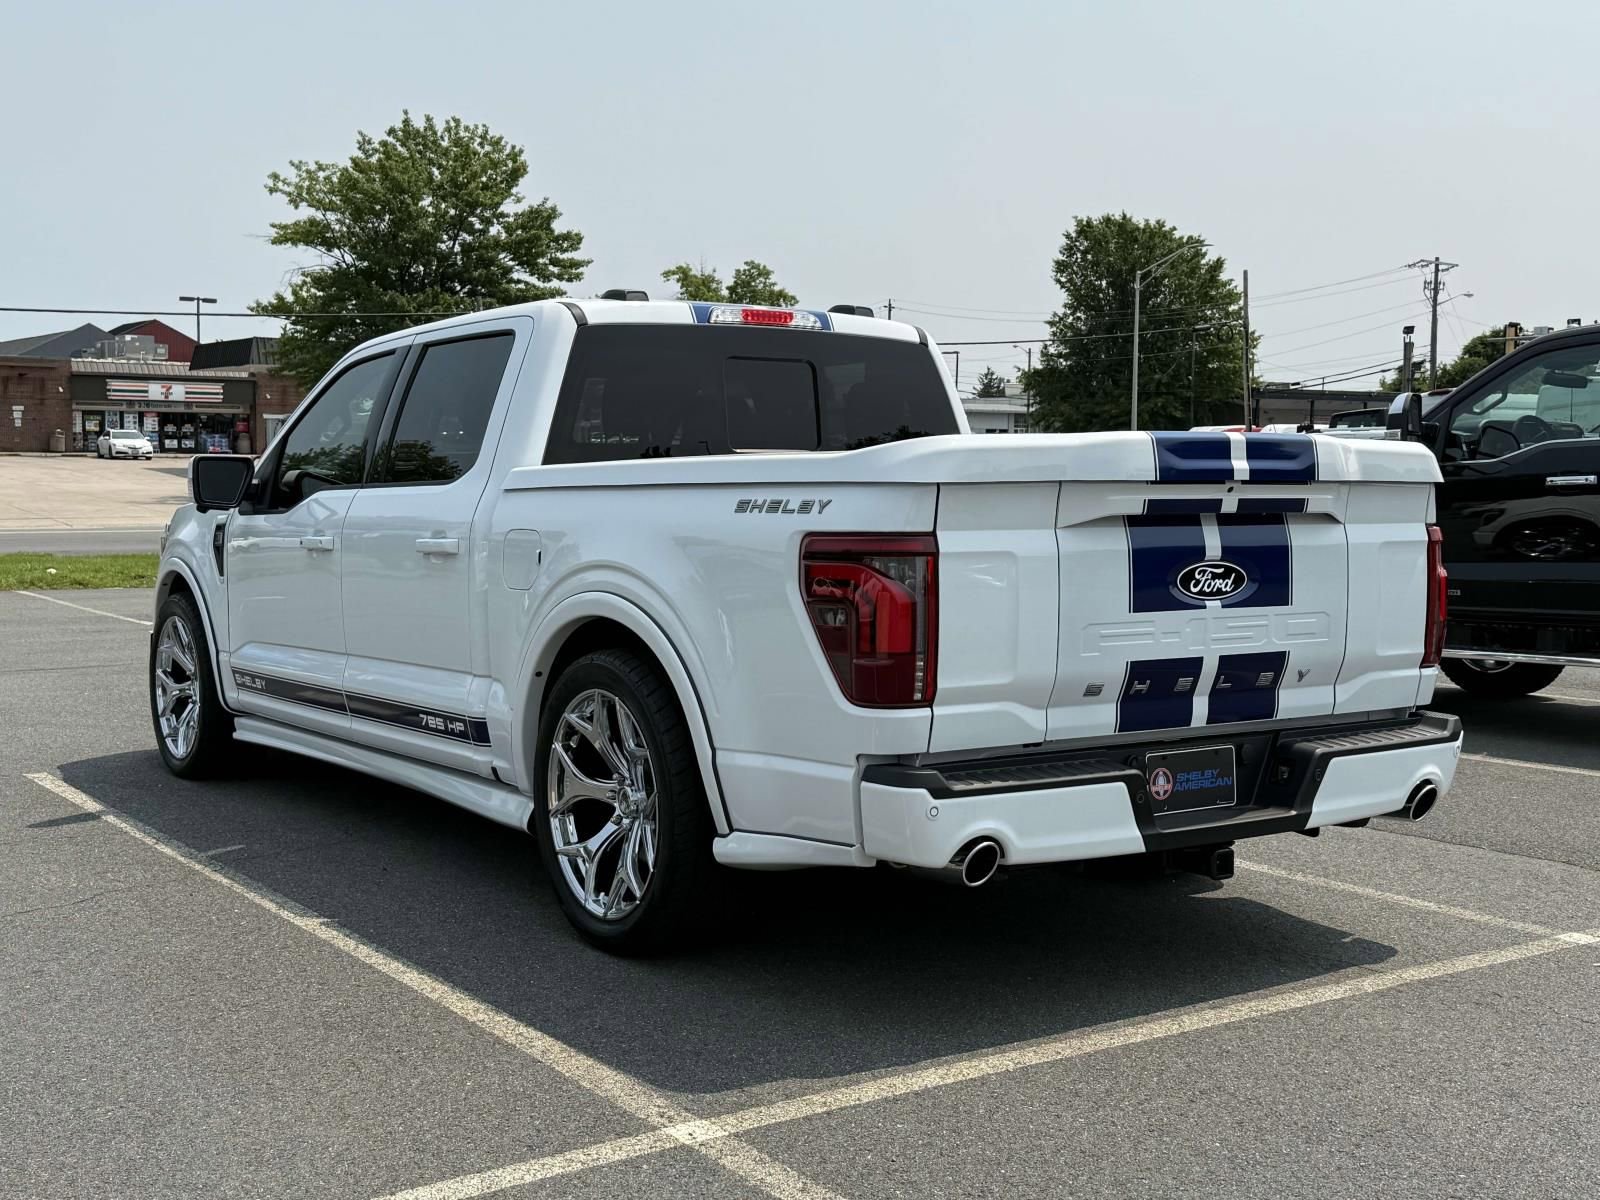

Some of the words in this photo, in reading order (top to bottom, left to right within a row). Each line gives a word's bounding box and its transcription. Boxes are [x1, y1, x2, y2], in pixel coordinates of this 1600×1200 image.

[734, 499, 833, 514] SHELBY
[1190, 567, 1235, 593] Ford
[1080, 611, 1330, 656] F-150
[234, 673, 266, 690] SHELBY
[447, 719, 465, 734] HP
[1176, 768, 1220, 782] SHELBY
[1174, 776, 1232, 792] AMERICAN
